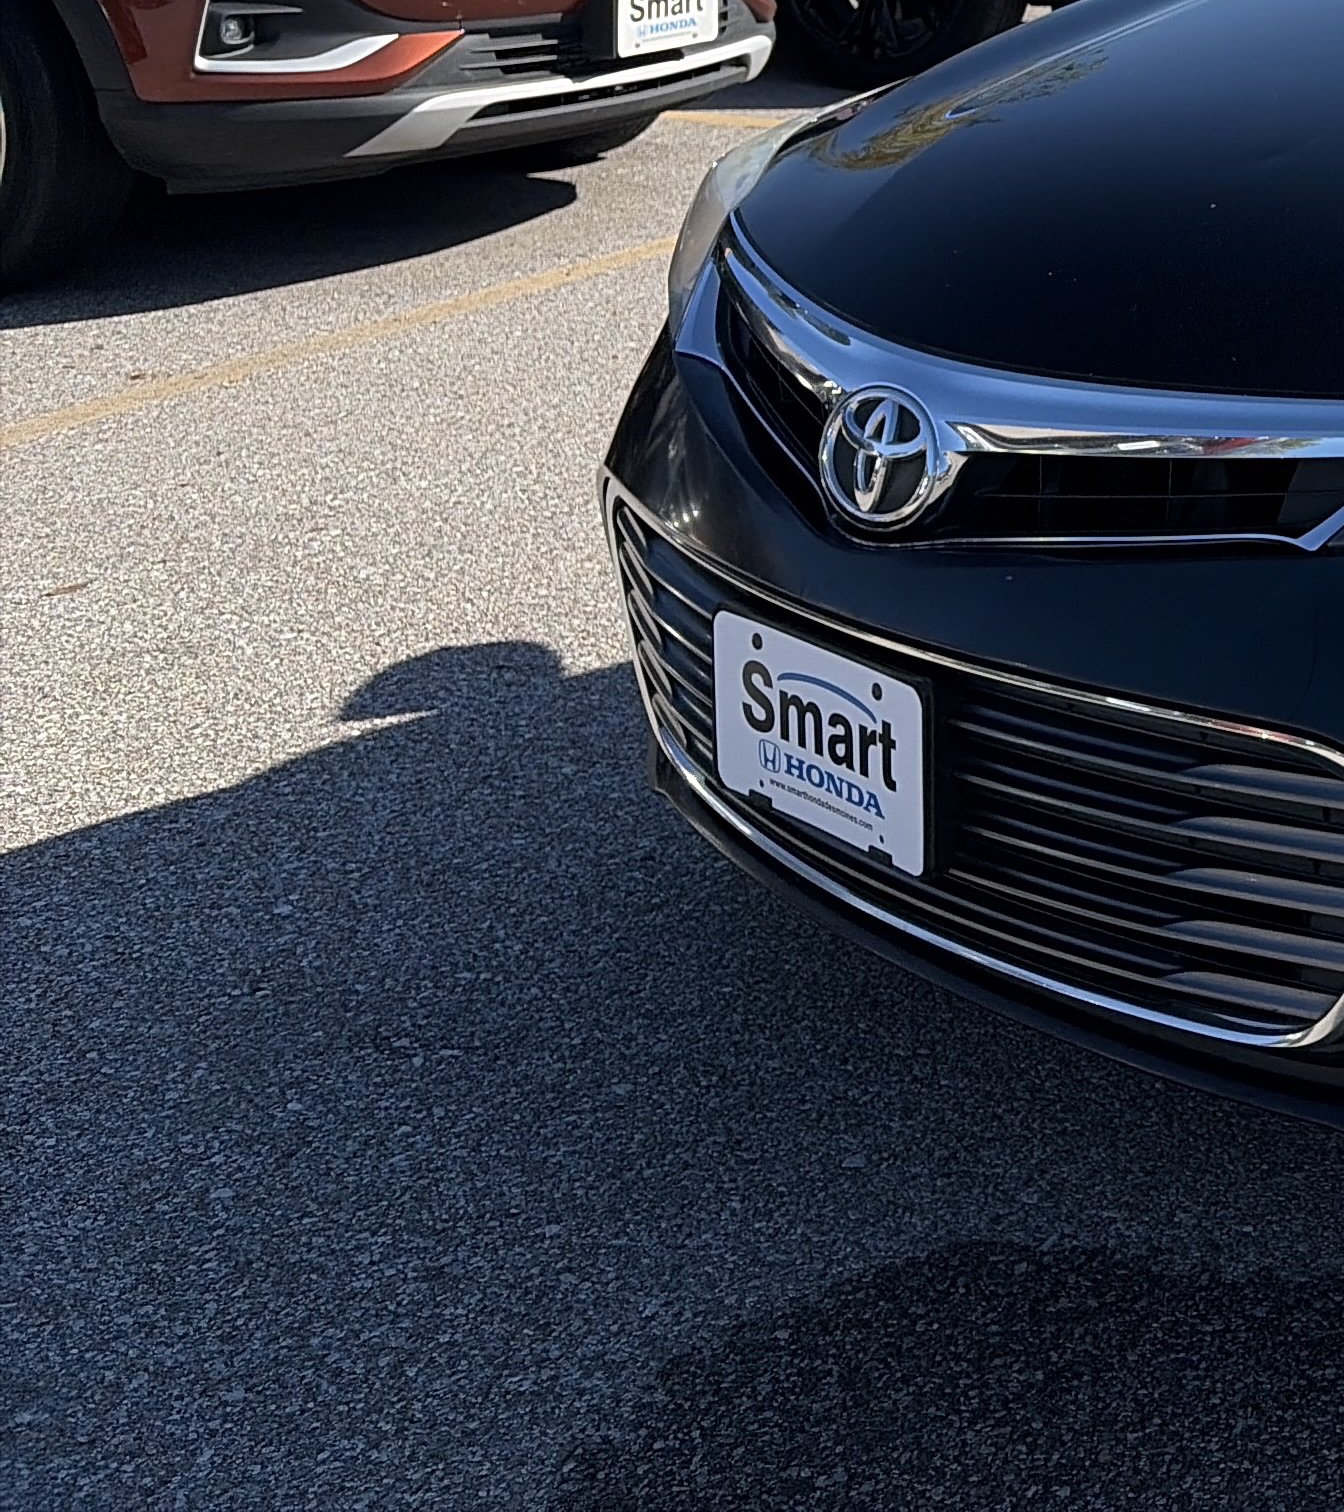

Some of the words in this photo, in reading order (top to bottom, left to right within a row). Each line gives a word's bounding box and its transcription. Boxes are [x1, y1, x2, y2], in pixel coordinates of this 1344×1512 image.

[649, 17, 697, 34] HONDA
[741, 660, 897, 792] Smart
[783, 752, 885, 820] HONDA
